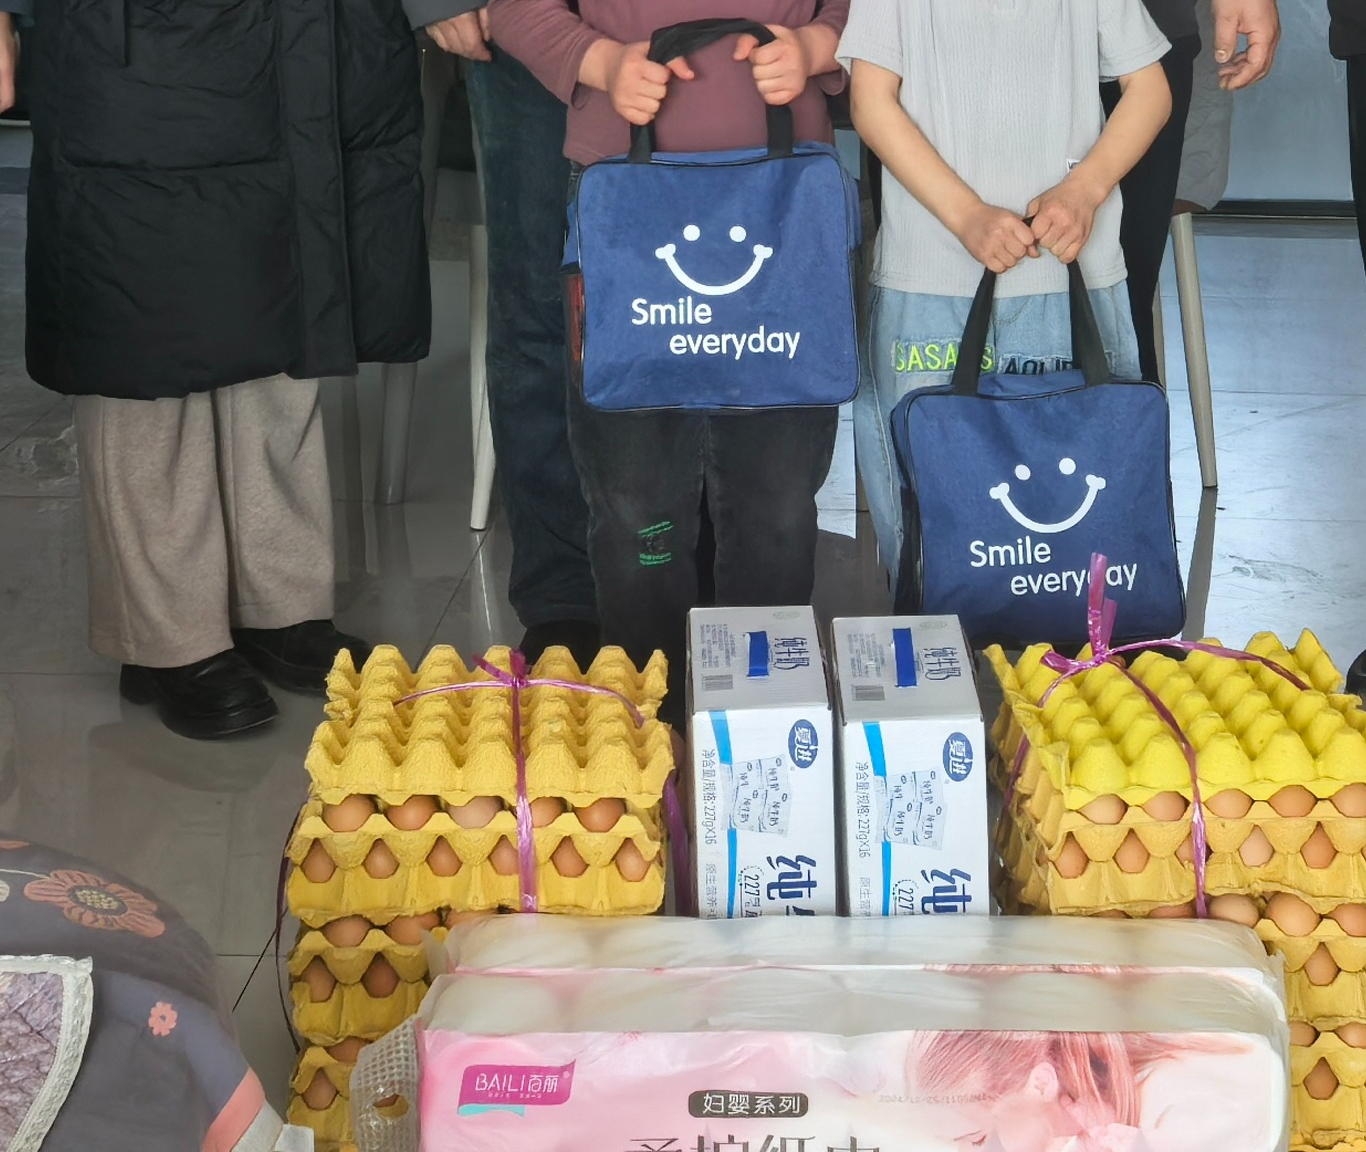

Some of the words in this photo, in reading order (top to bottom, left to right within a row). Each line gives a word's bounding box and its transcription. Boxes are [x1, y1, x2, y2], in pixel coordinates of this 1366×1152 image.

[631, 295, 712, 326] Smile
[669, 324, 801, 361] everyday
[969, 535, 1051, 568] Smile
[1010, 563, 1138, 597] everyay
[702, 1091, 801, 1116] 妇婴系列
